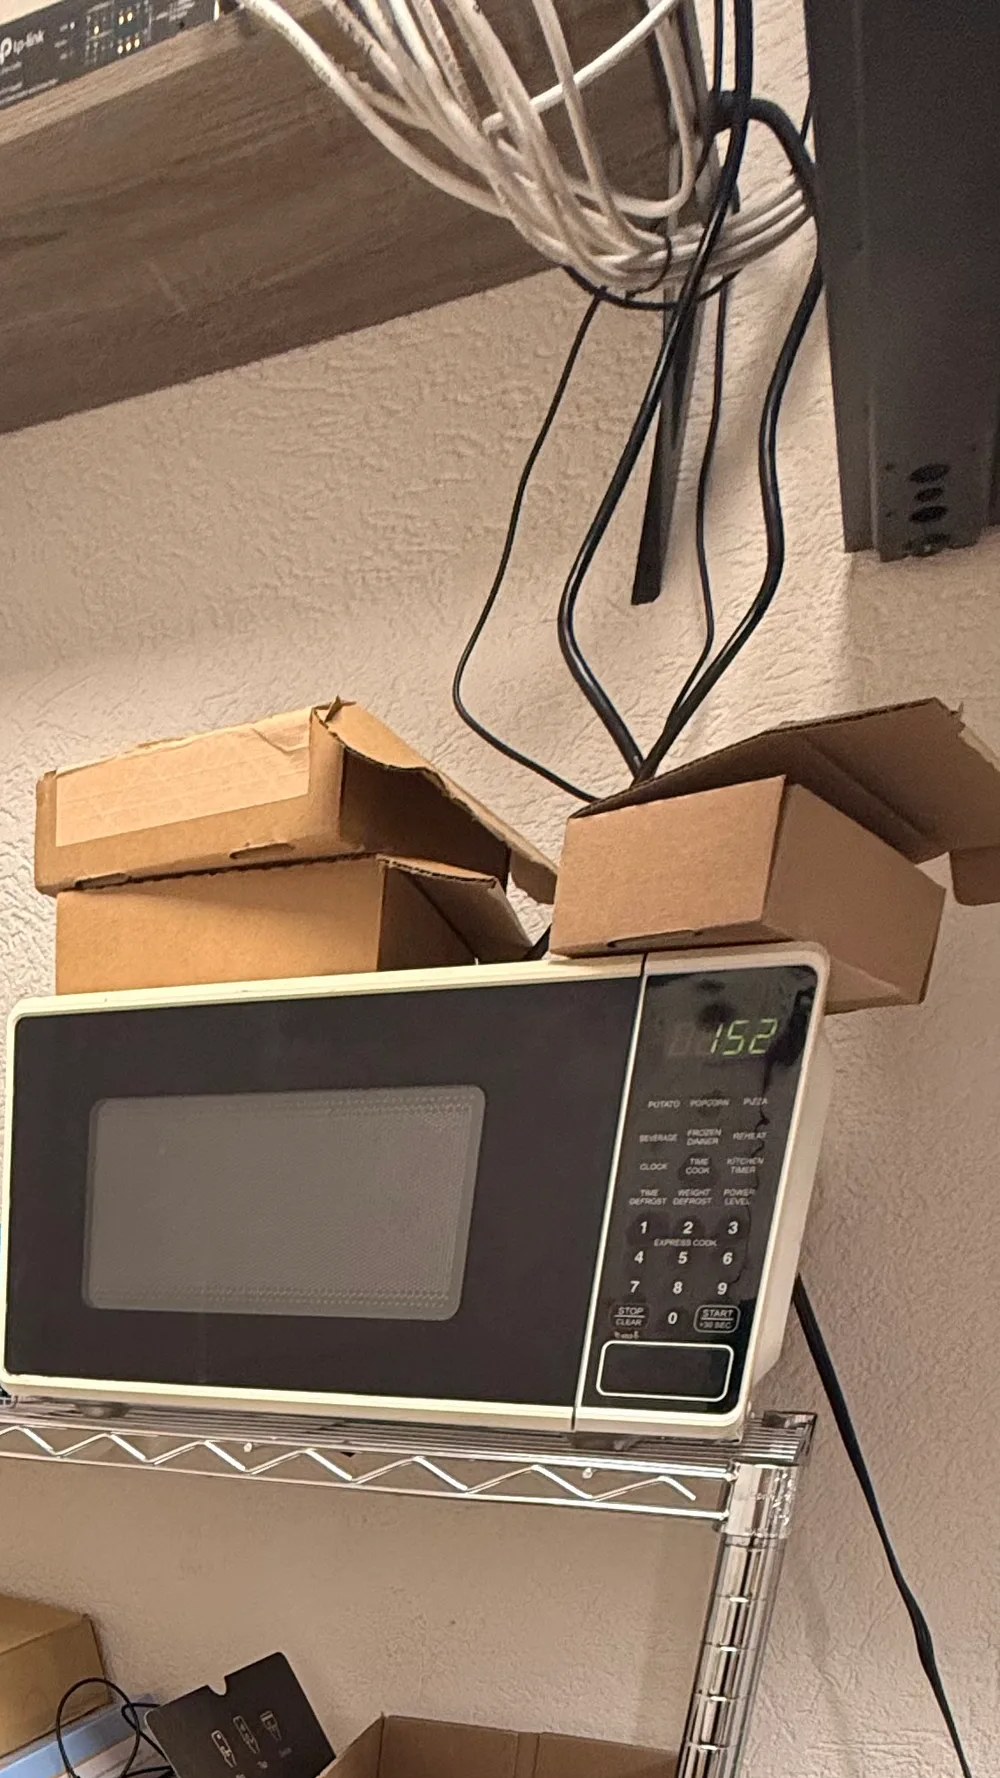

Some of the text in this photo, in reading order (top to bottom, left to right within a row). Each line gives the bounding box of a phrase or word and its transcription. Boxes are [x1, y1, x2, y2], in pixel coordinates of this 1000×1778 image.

[647, 1098, 768, 1108] POTATO POPCORN PIZZA
[686, 1128, 722, 1137] FROZEN
[732, 1132, 768, 1140] REHEAT
[639, 1134, 678, 1142] BEVERAGE
[686, 1138, 719, 1146] DINNER
[726, 1157, 765, 1165] KITCHEN
[639, 1163, 668, 1171] CLOCK
[685, 1166, 710, 1174] COOK
[730, 1166, 756, 1174] TIMER
[640, 1189, 660, 1197] TIME
[677, 1188, 712, 1197] WEIGHT
[723, 1188, 756, 1197] POWER
[628, 1197, 668, 1206] DEFROST
[672, 1197, 713, 1206] DEFROST
[724, 1197, 751, 1206] LEVEL
[640, 1221, 648, 1235] 1
[682, 1221, 694, 1235] 2
[727, 1221, 739, 1235] 3
[653, 1238, 718, 1247] EXPRESS COOK
[634, 1251, 645, 1265] 4
[678, 1251, 688, 1265] 5
[722, 1252, 733, 1265] 6
[629, 1280, 641, 1294] 7
[672, 1281, 683, 1295] 8
[717, 1282, 728, 1295] 9
[618, 1306, 644, 1315] STOP
[702, 1309, 734, 1318] START
[615, 1318, 642, 1326] CLEAR
[667, 1311, 678, 1325] 0
